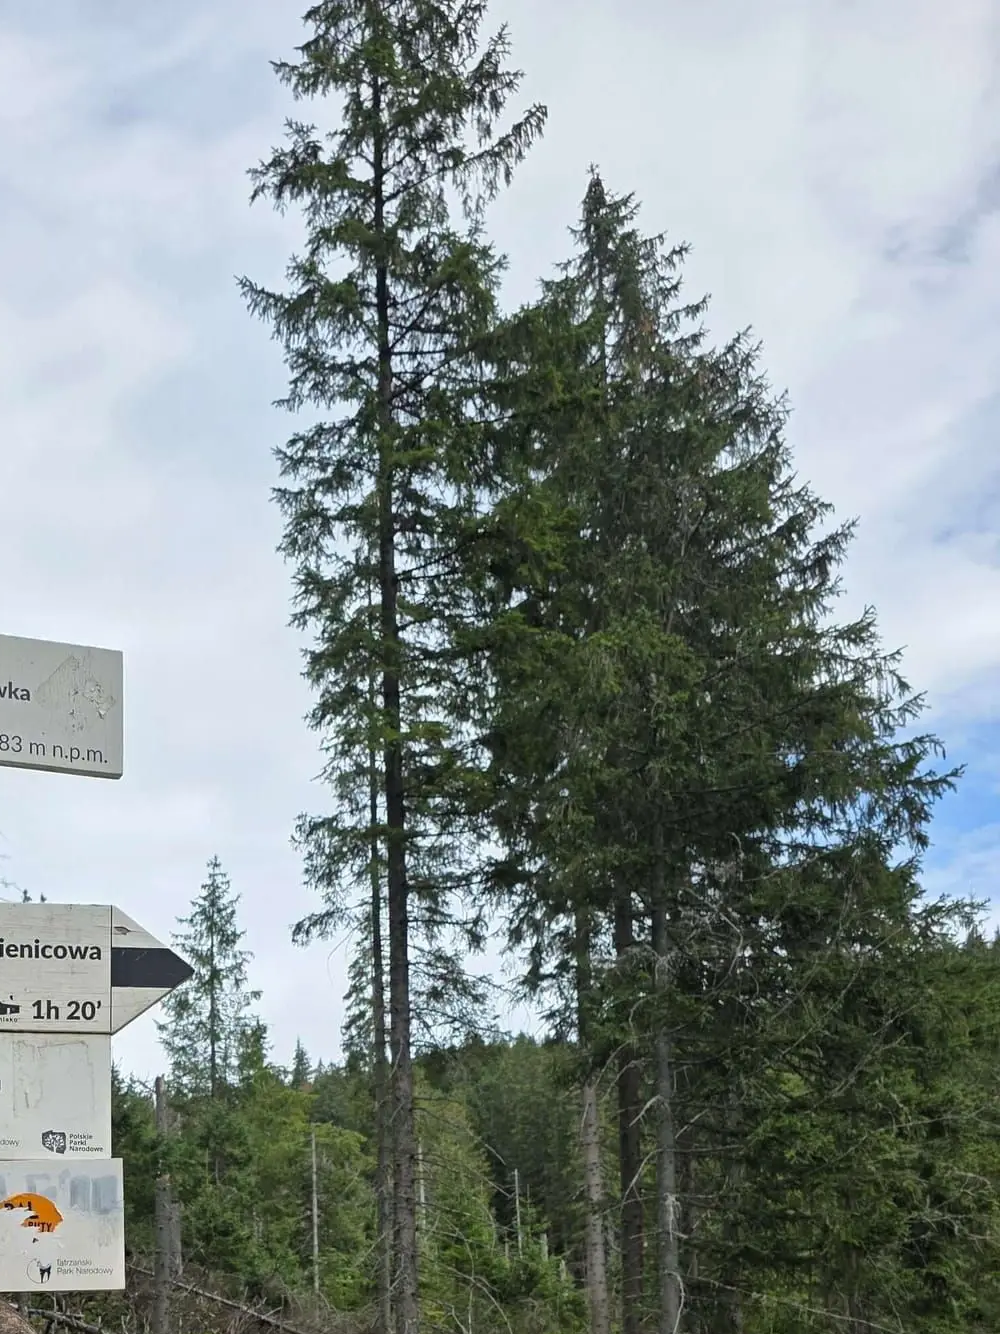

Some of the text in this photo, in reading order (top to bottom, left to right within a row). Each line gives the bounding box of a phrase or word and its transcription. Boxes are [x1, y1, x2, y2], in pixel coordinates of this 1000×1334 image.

[29, 741, 46, 756] m
[52, 744, 108, 763] n.p.m.
[31, 1000, 102, 1021] 1h 20'
[75, 1267, 114, 1276] Narodowy
